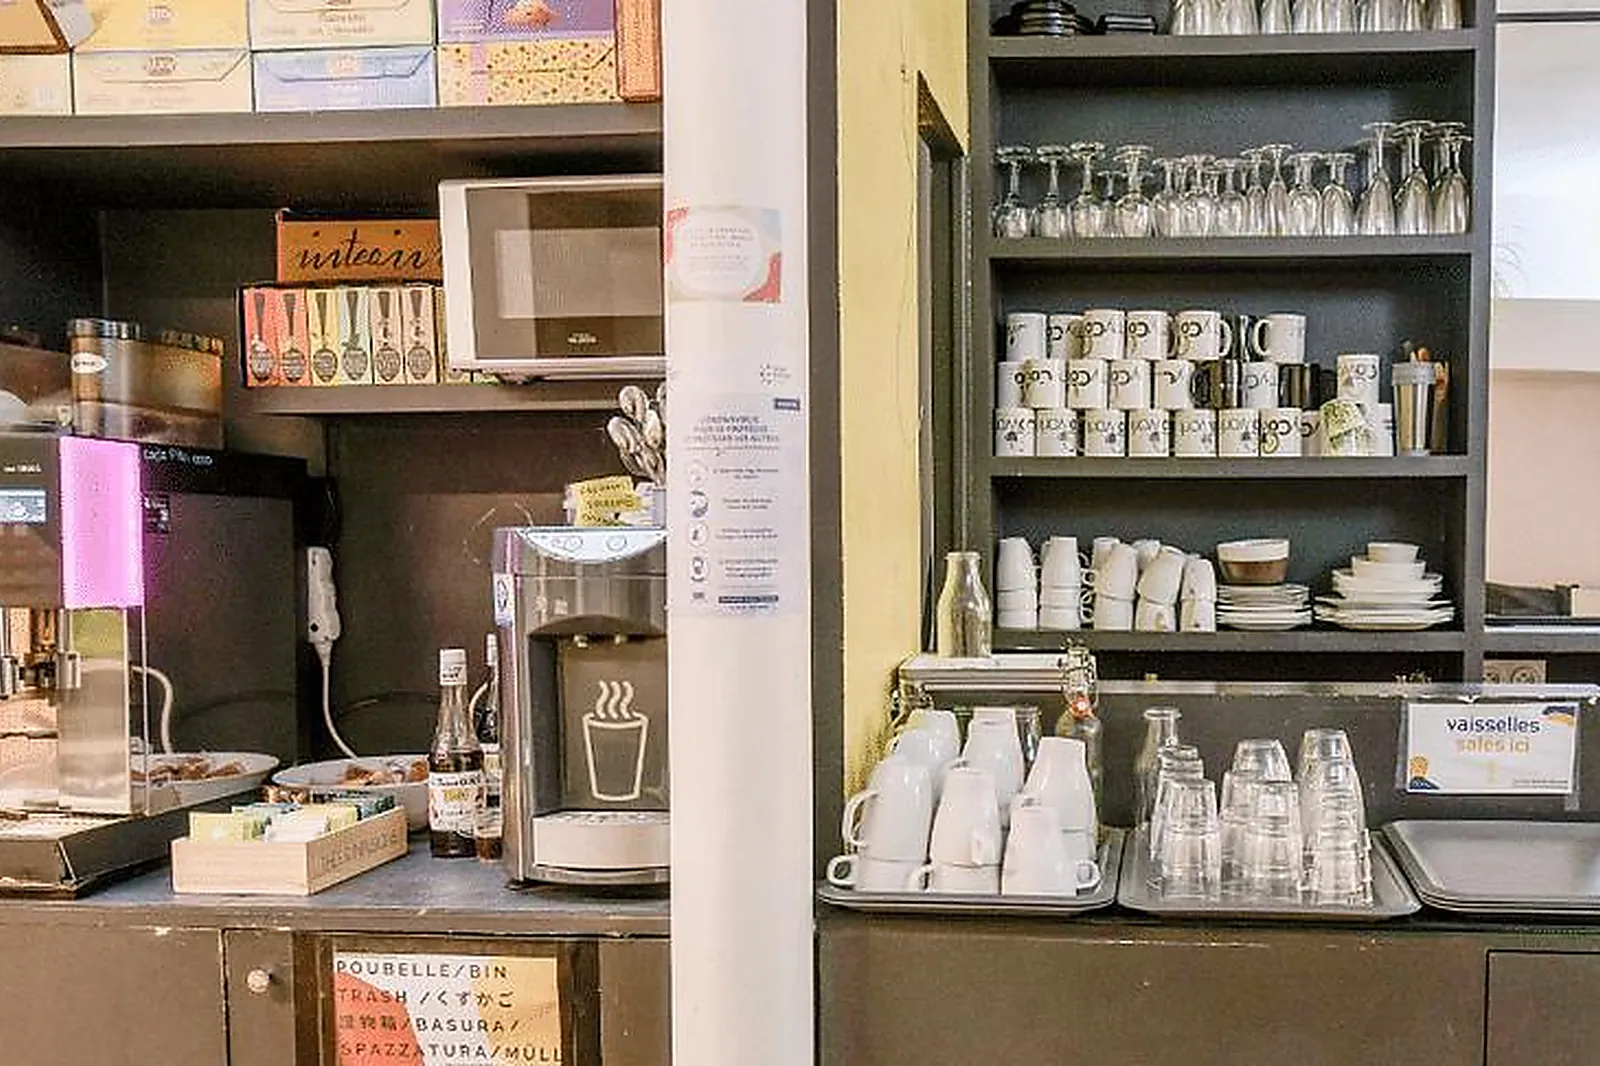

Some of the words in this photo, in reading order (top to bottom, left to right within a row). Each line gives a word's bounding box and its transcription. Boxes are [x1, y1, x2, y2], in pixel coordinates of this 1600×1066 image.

[1446, 716, 1541, 733] vaisselles
[1457, 737, 1505, 754] sales
[1509, 737, 1531, 754] ici
[337, 989, 408, 1005] TRASH
